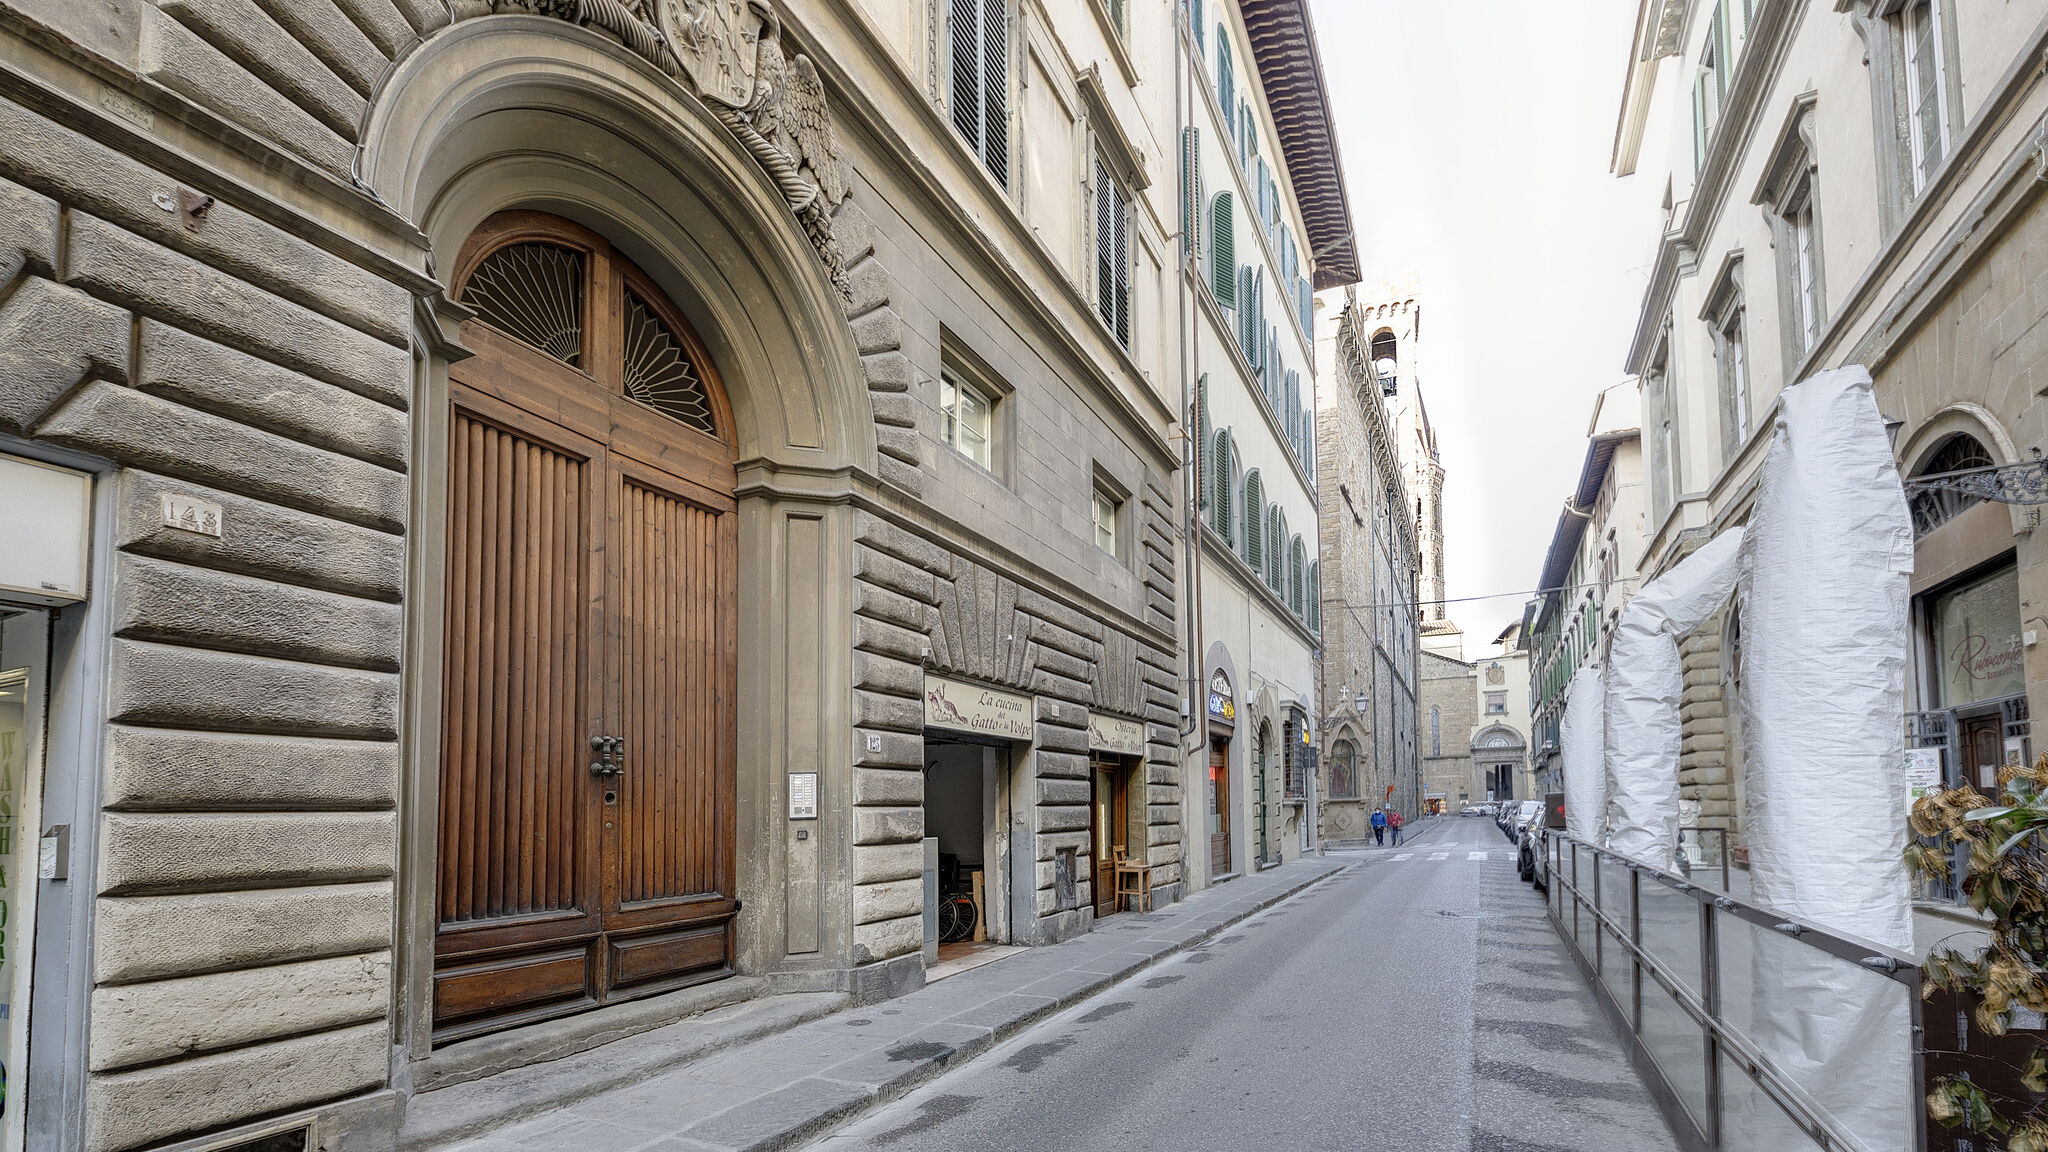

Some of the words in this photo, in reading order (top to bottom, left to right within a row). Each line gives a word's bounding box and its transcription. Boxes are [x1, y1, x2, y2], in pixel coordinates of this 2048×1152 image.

[170, 502, 217, 527] 143
[978, 692, 993, 706] La
[995, 697, 1023, 712] cucina
[971, 713, 998, 730] Gatto
[1010, 720, 1032, 737] Volpe
[1115, 721, 1137, 734] Osteria
